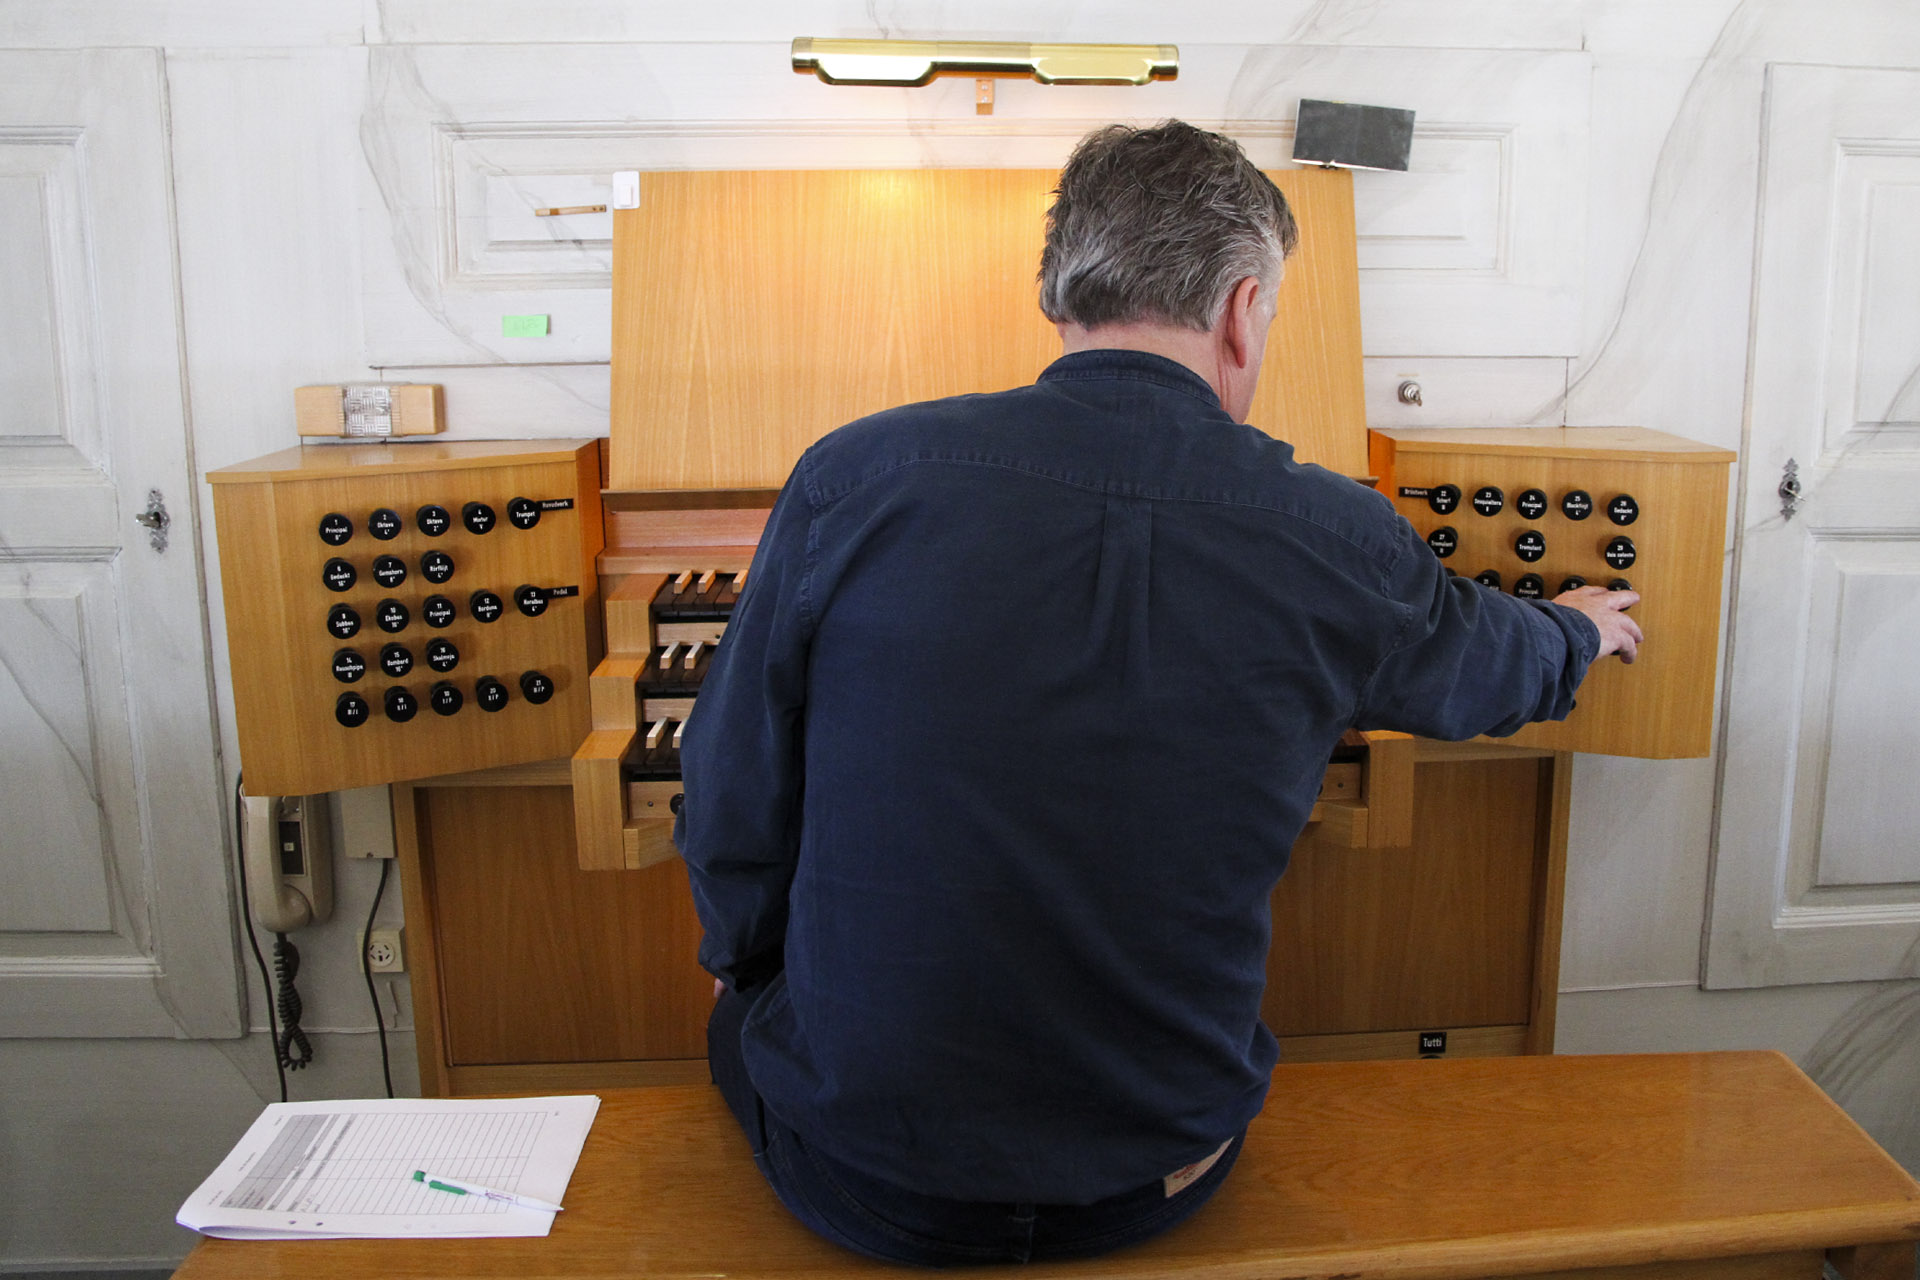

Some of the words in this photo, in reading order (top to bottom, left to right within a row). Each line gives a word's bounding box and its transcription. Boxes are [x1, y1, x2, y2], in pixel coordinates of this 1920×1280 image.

[1521, 501, 1542, 509] Principal
[516, 511, 536, 519] Trumpet
[325, 526, 348, 534] Principal
[379, 569, 403, 577] Gemshorn
[553, 588, 568, 596] Pedal
[429, 609, 451, 617] Principal
[1423, 1037, 1442, 1047] Tutti
